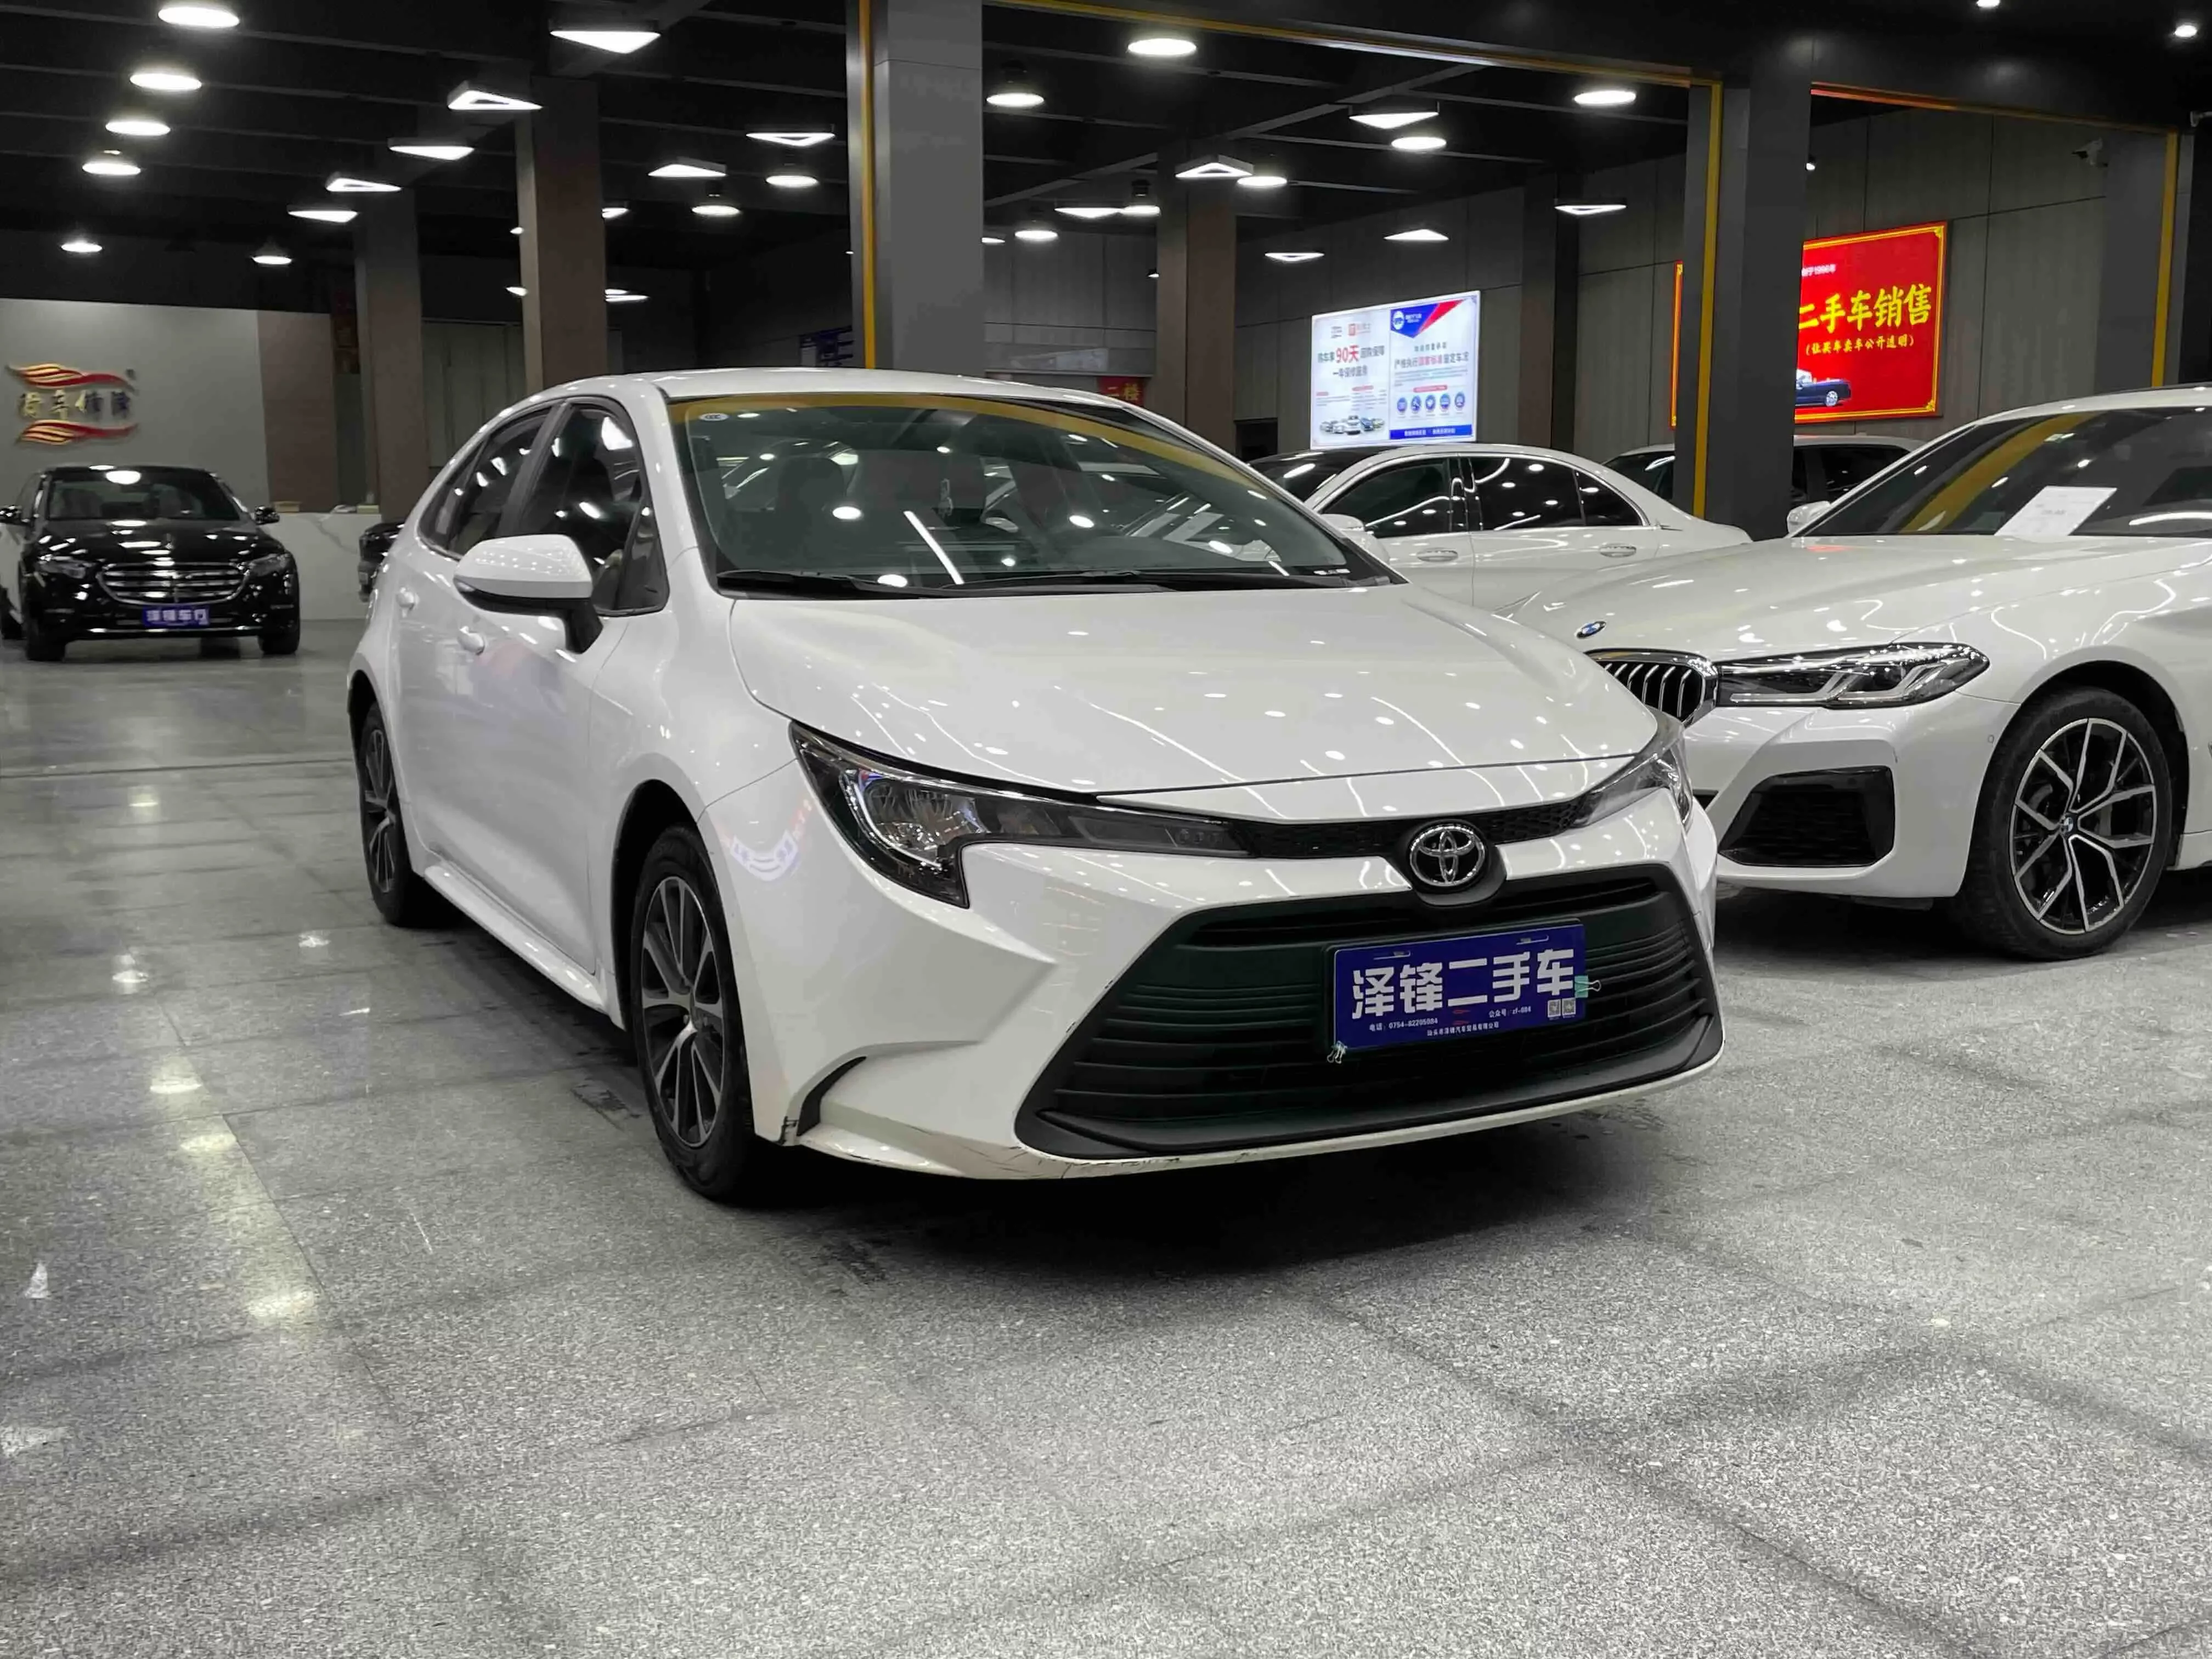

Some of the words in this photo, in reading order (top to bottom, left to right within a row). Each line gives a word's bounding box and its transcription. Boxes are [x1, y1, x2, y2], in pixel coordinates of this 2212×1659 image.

[1799, 284, 1932, 334] 二手车销售
[1352, 949, 1574, 1020] 泽锋二手车
